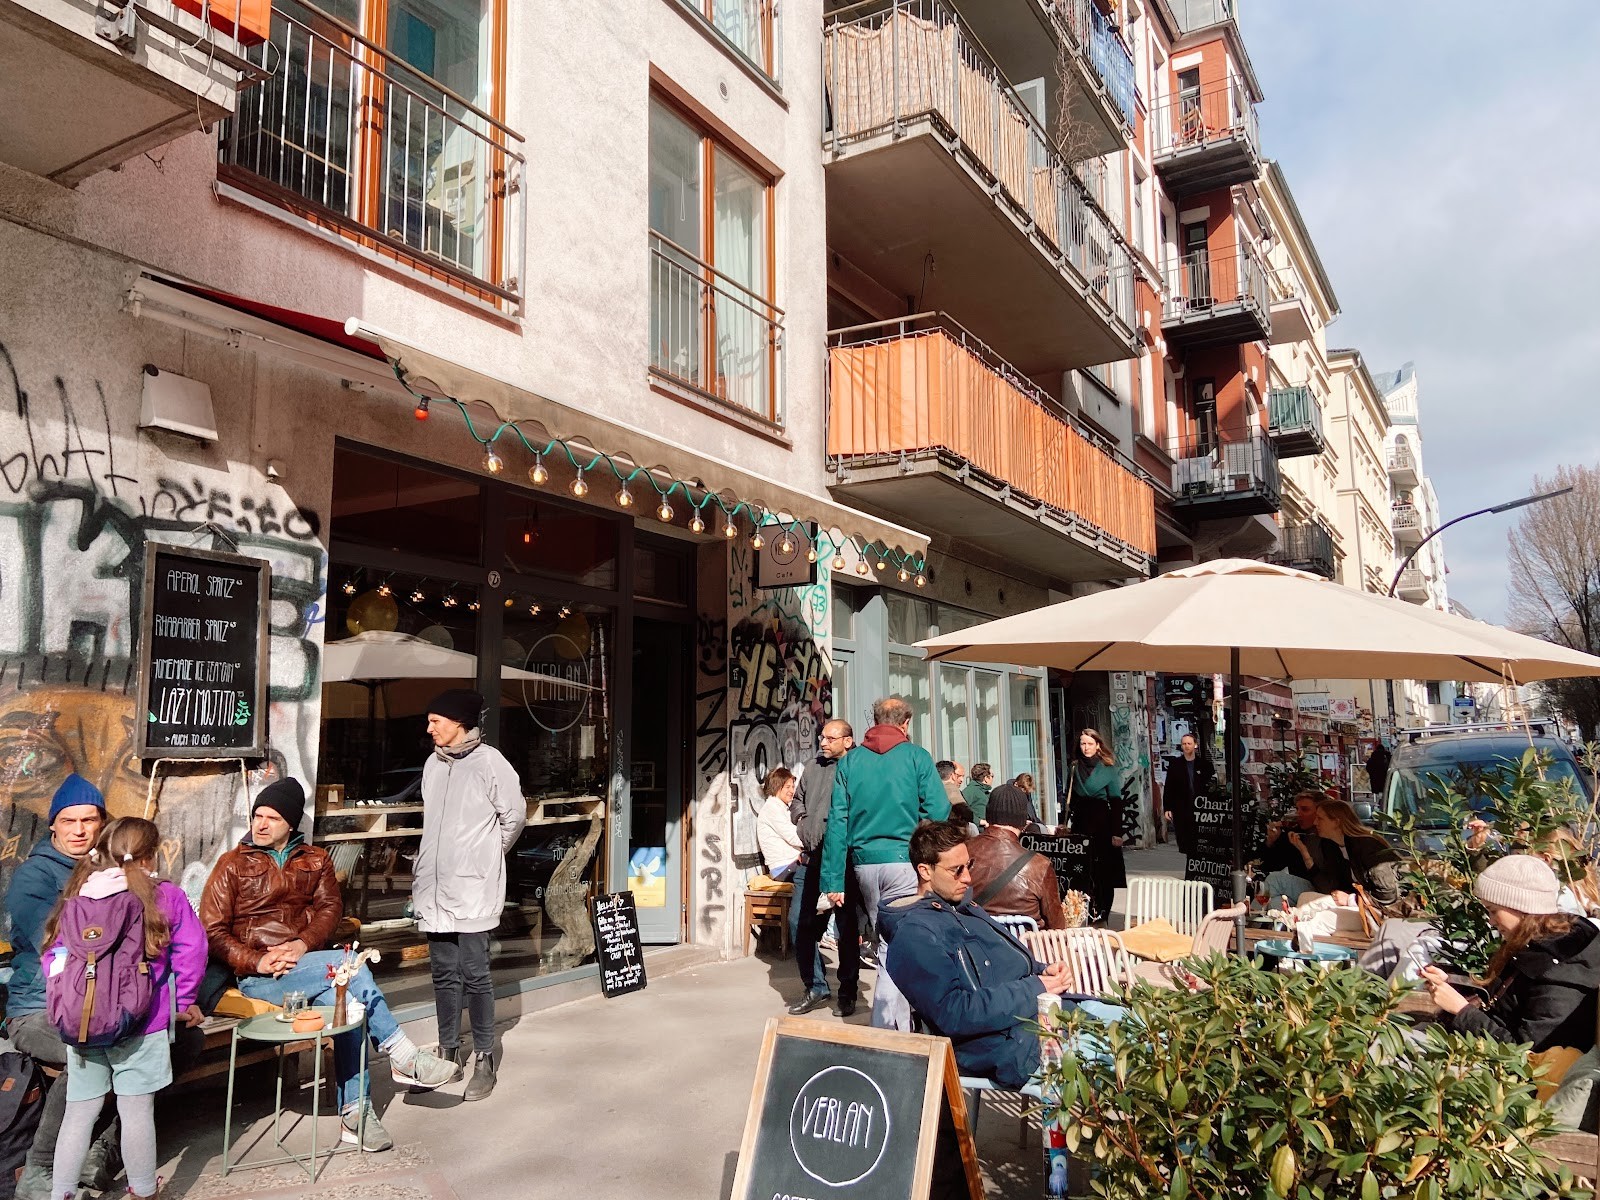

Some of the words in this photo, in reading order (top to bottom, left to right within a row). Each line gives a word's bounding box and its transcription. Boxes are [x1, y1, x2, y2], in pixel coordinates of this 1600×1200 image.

[166, 569, 200, 594] APEROL
[205, 575, 235, 599] SPRITZ
[775, 571, 793, 579] Café
[155, 614, 201, 641] RHABARBER
[204, 619, 230, 643] SPRITZ
[152, 658, 193, 682] HOMEMADE
[532, 663, 581, 701] VERLAN
[159, 686, 193, 725] LAZY
[193, 688, 235, 727] MOJITO
[191, 734, 200, 746] TO
[200, 734, 210, 746] GO
[1193, 795, 1252, 813] Charia
[1193, 811, 1226, 824] TOAST
[1020, 835, 1085, 855] ChariTea
[1187, 857, 1232, 878] BRÖTCHEN
[801, 1096, 873, 1149] VERLAN
